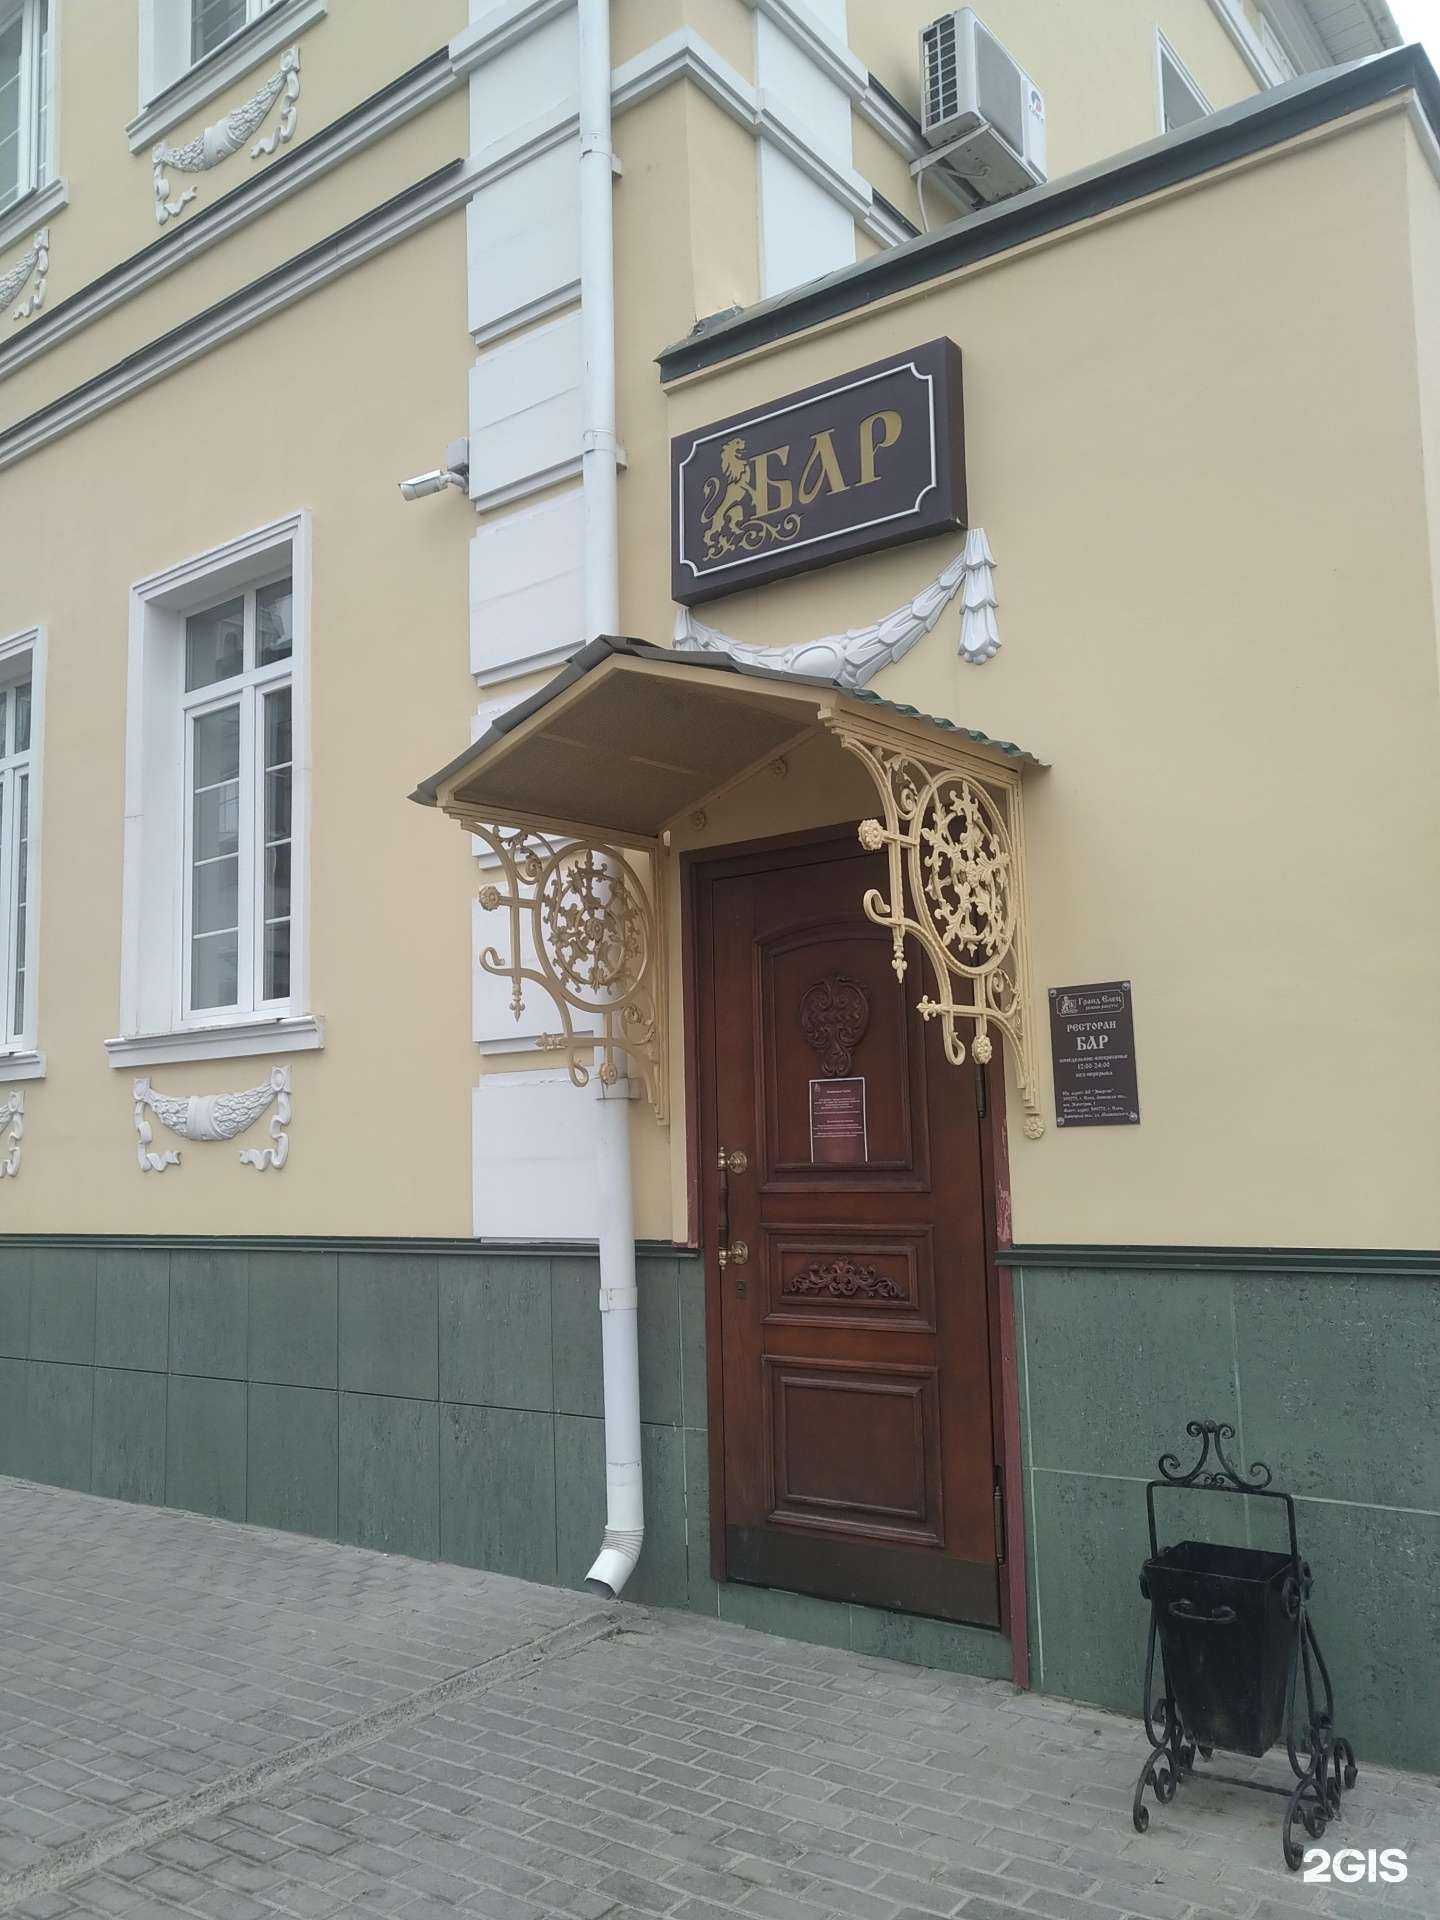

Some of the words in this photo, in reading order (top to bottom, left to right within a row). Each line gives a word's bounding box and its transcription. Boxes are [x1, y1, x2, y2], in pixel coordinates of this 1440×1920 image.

[749, 409, 903, 519] БАР
[1066, 1021, 1117, 1032] РЕСТОРАН
[1077, 1034, 1109, 1051] БАР
